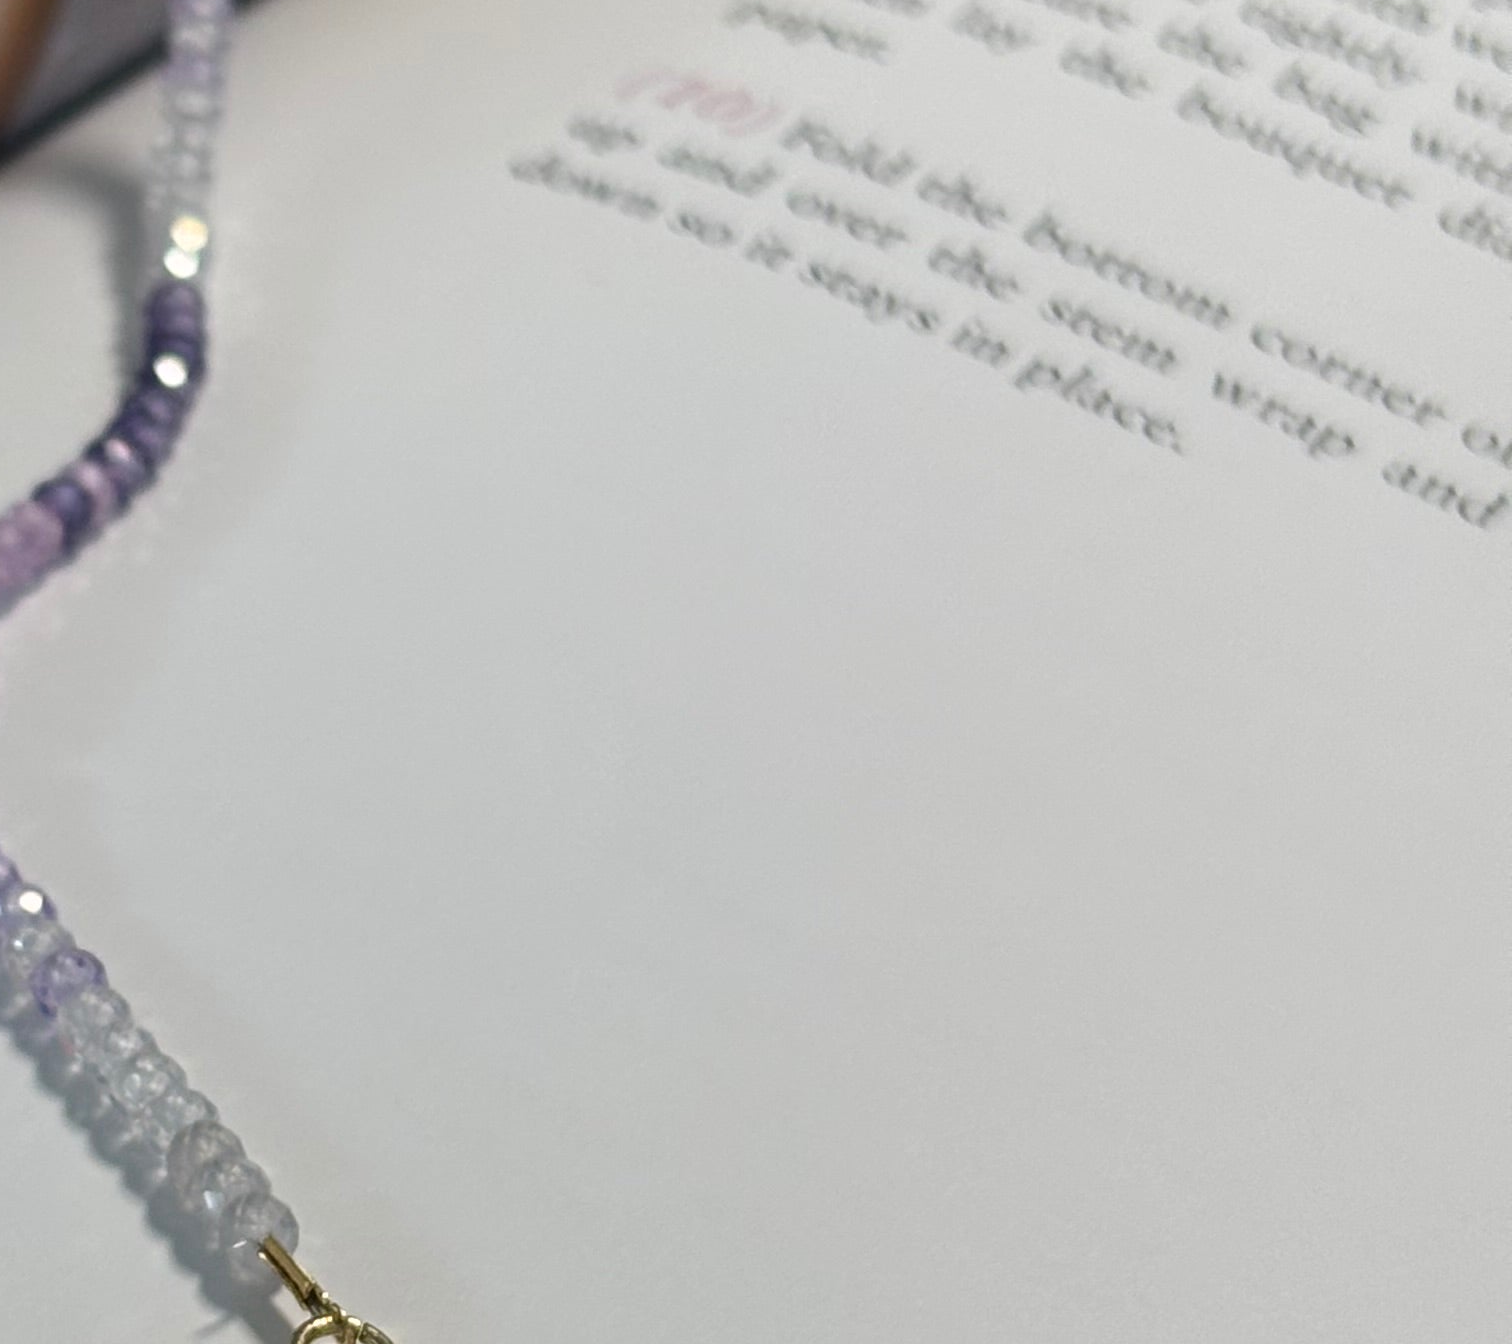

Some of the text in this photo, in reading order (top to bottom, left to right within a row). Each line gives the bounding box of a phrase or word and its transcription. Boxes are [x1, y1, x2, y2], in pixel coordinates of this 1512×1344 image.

[1059, 41, 1153, 99] the
[1175, 82, 1416, 210] bouquet
[1156, 21, 1253, 78] the
[509, 150, 1185, 457] down so it stays in place.
[567, 115, 1512, 532] up and over the stem wrap and
[779, 115, 920, 188] Fold
[915, 172, 1012, 230] the
[1021, 205, 1238, 332] bottom
[1249, 322, 1450, 430] corner
